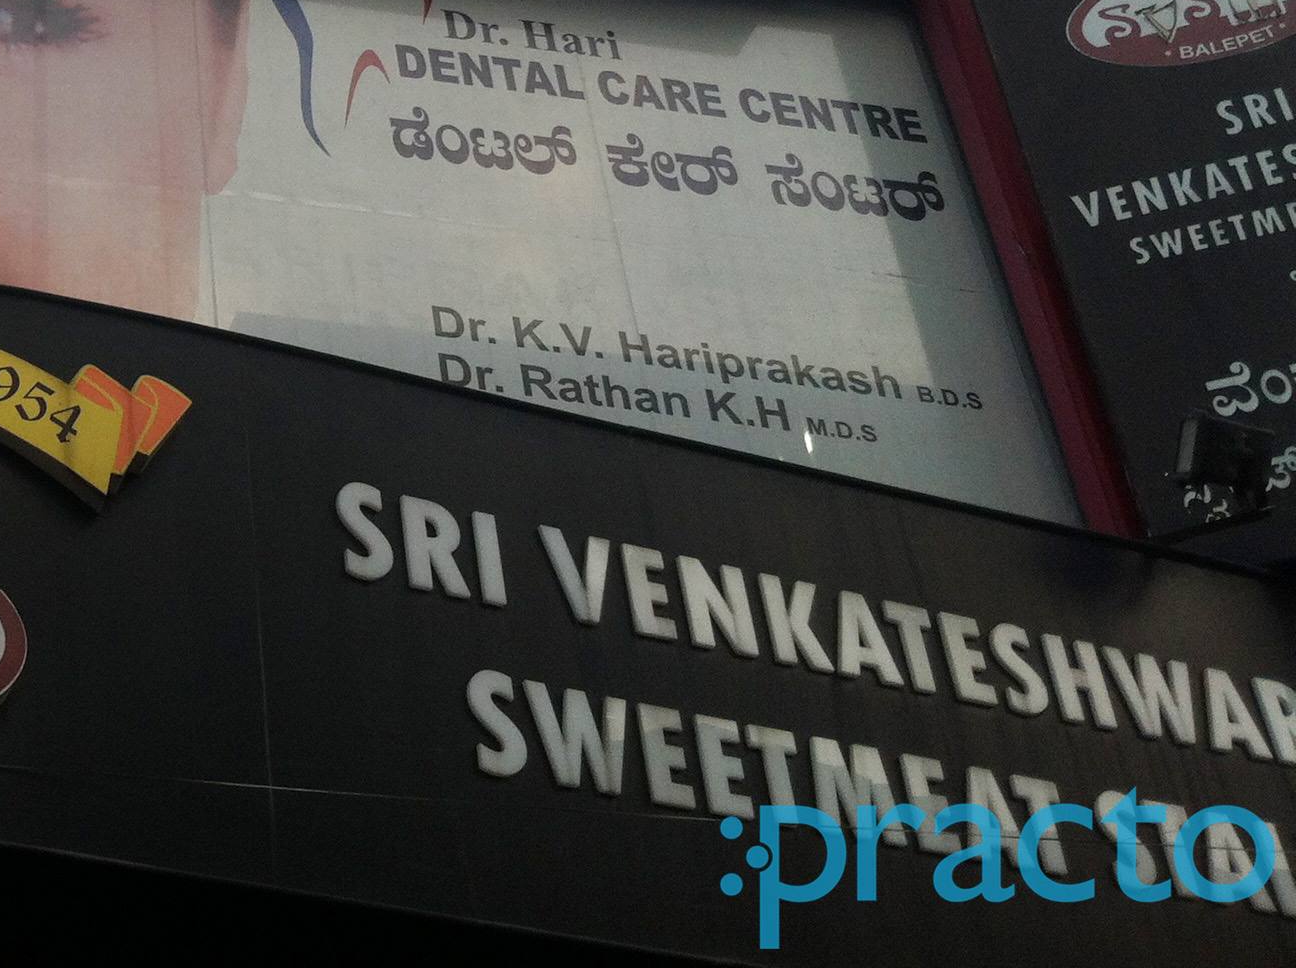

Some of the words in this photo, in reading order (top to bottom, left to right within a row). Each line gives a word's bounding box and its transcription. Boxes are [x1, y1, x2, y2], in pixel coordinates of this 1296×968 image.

[440, 8, 509, 46] Dr.
[517, 18, 621, 60] Hari
[1179, 24, 1275, 61] BALEPET
[395, 43, 585, 101] DENTAL
[597, 70, 726, 119] CARE
[738, 88, 928, 144] CENTRE
[1216, 87, 1295, 135] SRI
[389, 105, 577, 175] ಡೆಂಟಲ್
[606, 132, 738, 196] ಕೇರ್
[765, 153, 945, 221] ಸೆಂಟರ್
[431, 304, 497, 345] Dr.
[512, 316, 604, 359] K.V.
[620, 330, 903, 400] Hariprakash
[438, 352, 504, 393] Dr.
[519, 363, 691, 419] Rathan
[705, 388, 792, 432] K.H
[335, 481, 507, 607] SRI
[464, 669, 1069, 878] SWEETMEAT
